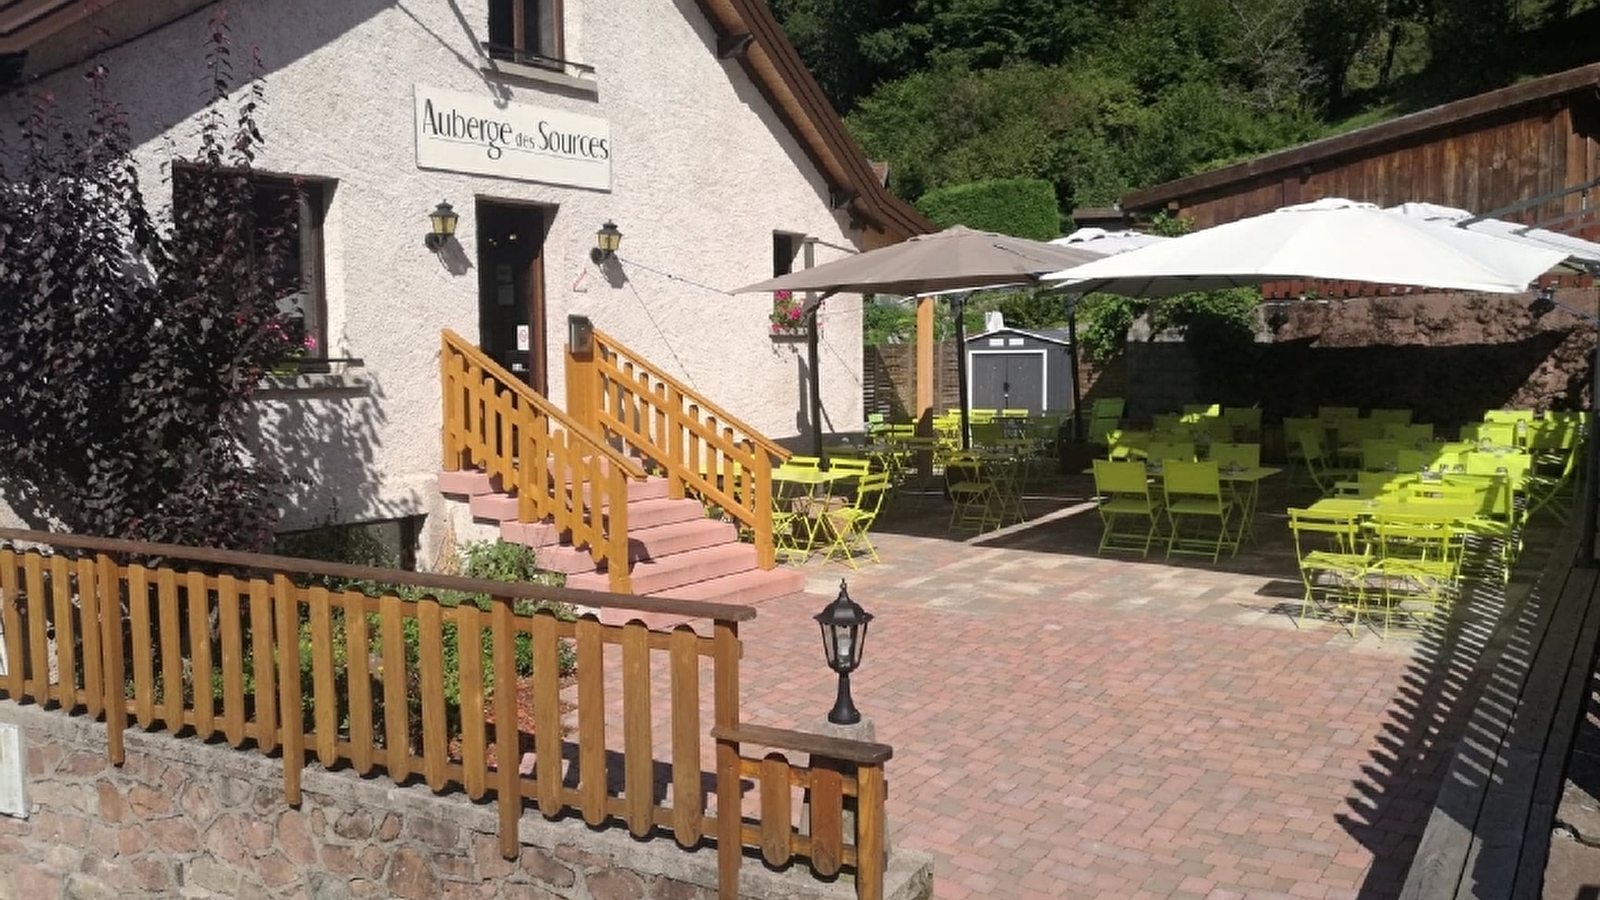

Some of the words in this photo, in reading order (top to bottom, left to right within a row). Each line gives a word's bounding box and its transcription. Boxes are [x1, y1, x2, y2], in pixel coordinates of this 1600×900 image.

[423, 98, 513, 160] Auberge
[515, 132, 535, 149] des
[538, 120, 609, 160] Sources
